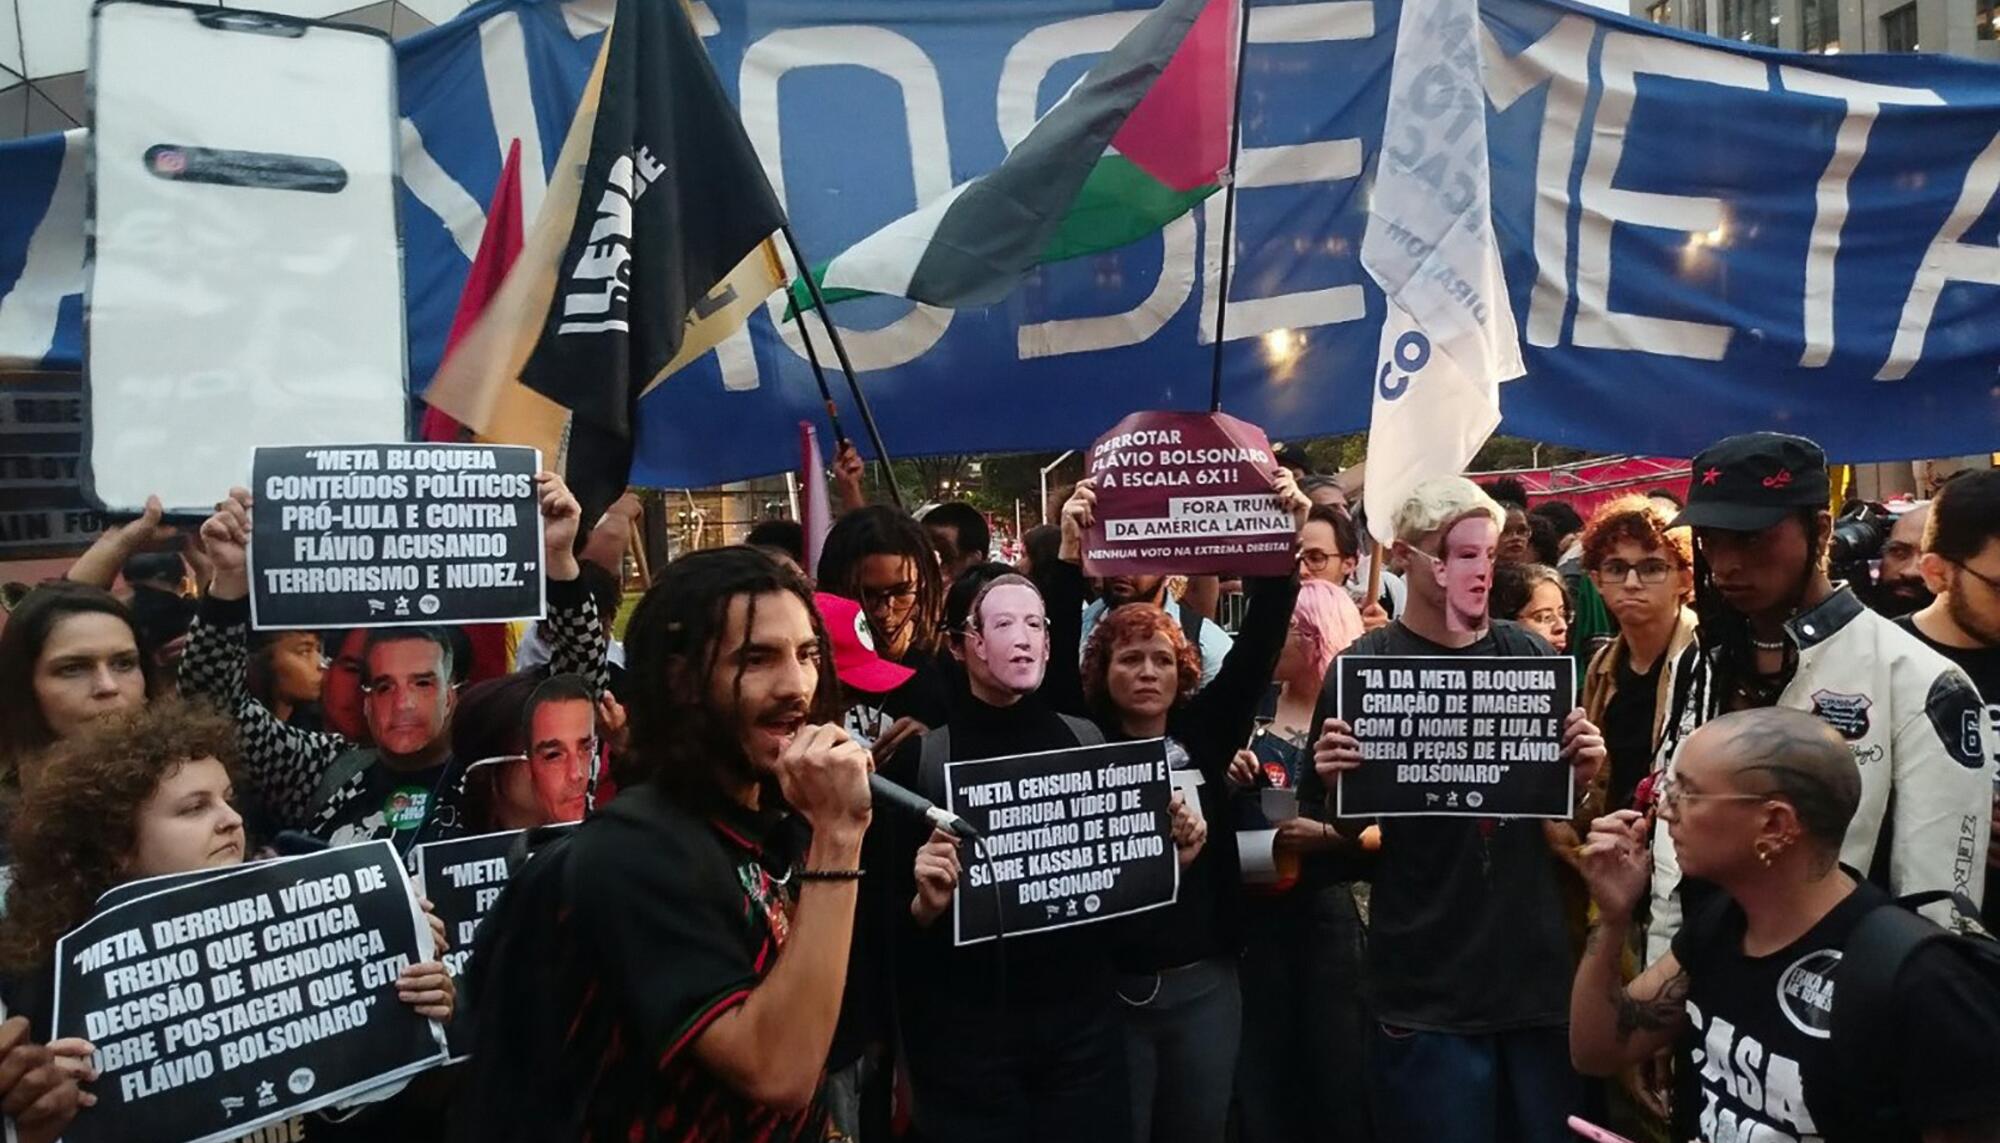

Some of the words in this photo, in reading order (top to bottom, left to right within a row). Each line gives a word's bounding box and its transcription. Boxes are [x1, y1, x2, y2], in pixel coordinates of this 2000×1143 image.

[1094, 430, 1182, 457] DERROTAR
[305, 450, 379, 470] “META
[387, 450, 496, 472] BLOQUEIA
[1091, 450, 1154, 473] FLÁVIO
[1160, 448, 1269, 465] BOLSONARO
[266, 472, 408, 500] CONTEÚDOS
[415, 471, 531, 498] POLÍTICOS
[1103, 473, 1116, 488] A
[1122, 470, 1190, 488] ESCALA
[1196, 468, 1239, 485] 6X1!
[282, 501, 399, 531] PRÓ-LULA
[406, 505, 419, 528] E
[426, 504, 517, 528] CONTRA
[1182, 499, 1229, 515] FORA
[1233, 498, 1287, 514] TRUM
[1115, 522, 1139, 537] DA
[1144, 517, 1220, 535] AMÉRICA
[1226, 516, 1290, 531] LATINA!
[294, 531, 375, 562] FLÁVIO
[382, 534, 507, 560] ACUSANDO
[1088, 548, 1137, 560] NENHUM
[1141, 546, 1171, 558] VOTO
[1174, 545, 1191, 557] NA
[1194, 543, 1244, 556] EXTREMA
[1247, 541, 1290, 553] DIREITA!
[264, 566, 419, 594] TERRORISMO
[427, 565, 440, 589] E
[1389, 669, 1413, 689] DA
[1420, 670, 1467, 690] META
[1472, 670, 1556, 692] BLOQUEIA
[1362, 691, 1439, 717] CRIAÇÃO
[1445, 695, 1467, 714] DE
[1472, 695, 1551, 714] IMAGENS
[1354, 718, 1394, 737] COM
[1400, 718, 1413, 737] O
[1418, 718, 1467, 737] NOME
[1473, 719, 1495, 737] DE
[1500, 719, 1541, 737] LULA
[1547, 719, 1557, 737] E
[1413, 741, 1468, 763] PEÇAS
[1473, 742, 1495, 760] DE
[1500, 738, 1560, 762] FLÁVIO
[959, 781, 1014, 808] “META
[1018, 770, 1092, 799] CENSURA
[1097, 763, 1152, 790] FÓRUM
[1157, 761, 1165, 781] E
[1397, 764, 1510, 784] BOLSONARO”
[989, 800, 1065, 831] DERRUBA
[1070, 792, 1116, 819] VÍDEO
[1121, 789, 1141, 810] DE
[1084, 817, 1104, 839] DE
[1108, 811, 1155, 837] ROVAI
[1028, 847, 1093, 876] KASSAB
[1098, 844, 1107, 864] E
[1111, 835, 1164, 861] FLÁVIO
[1018, 868, 1121, 904] BOLSONARO”
[152, 893, 275, 950] DERRUBA
[279, 873, 353, 914] VÍDEO
[356, 864, 387, 894] DE
[104, 949, 200, 1000] FREIXO
[206, 934, 258, 980] QUE
[265, 904, 360, 954] CRITICA
[85, 980, 206, 1042] DECISÃO
[213, 968, 246, 1001] DE
[252, 929, 385, 990] MENDONÇA
[90, 1031, 159, 1076] OBRE
[165, 993, 304, 1054] POSTAGEM
[310, 968, 358, 1010] QUE
[120, 1050, 215, 1103] FLÁVIO
[221, 995, 376, 1078] BOLSONARO”
